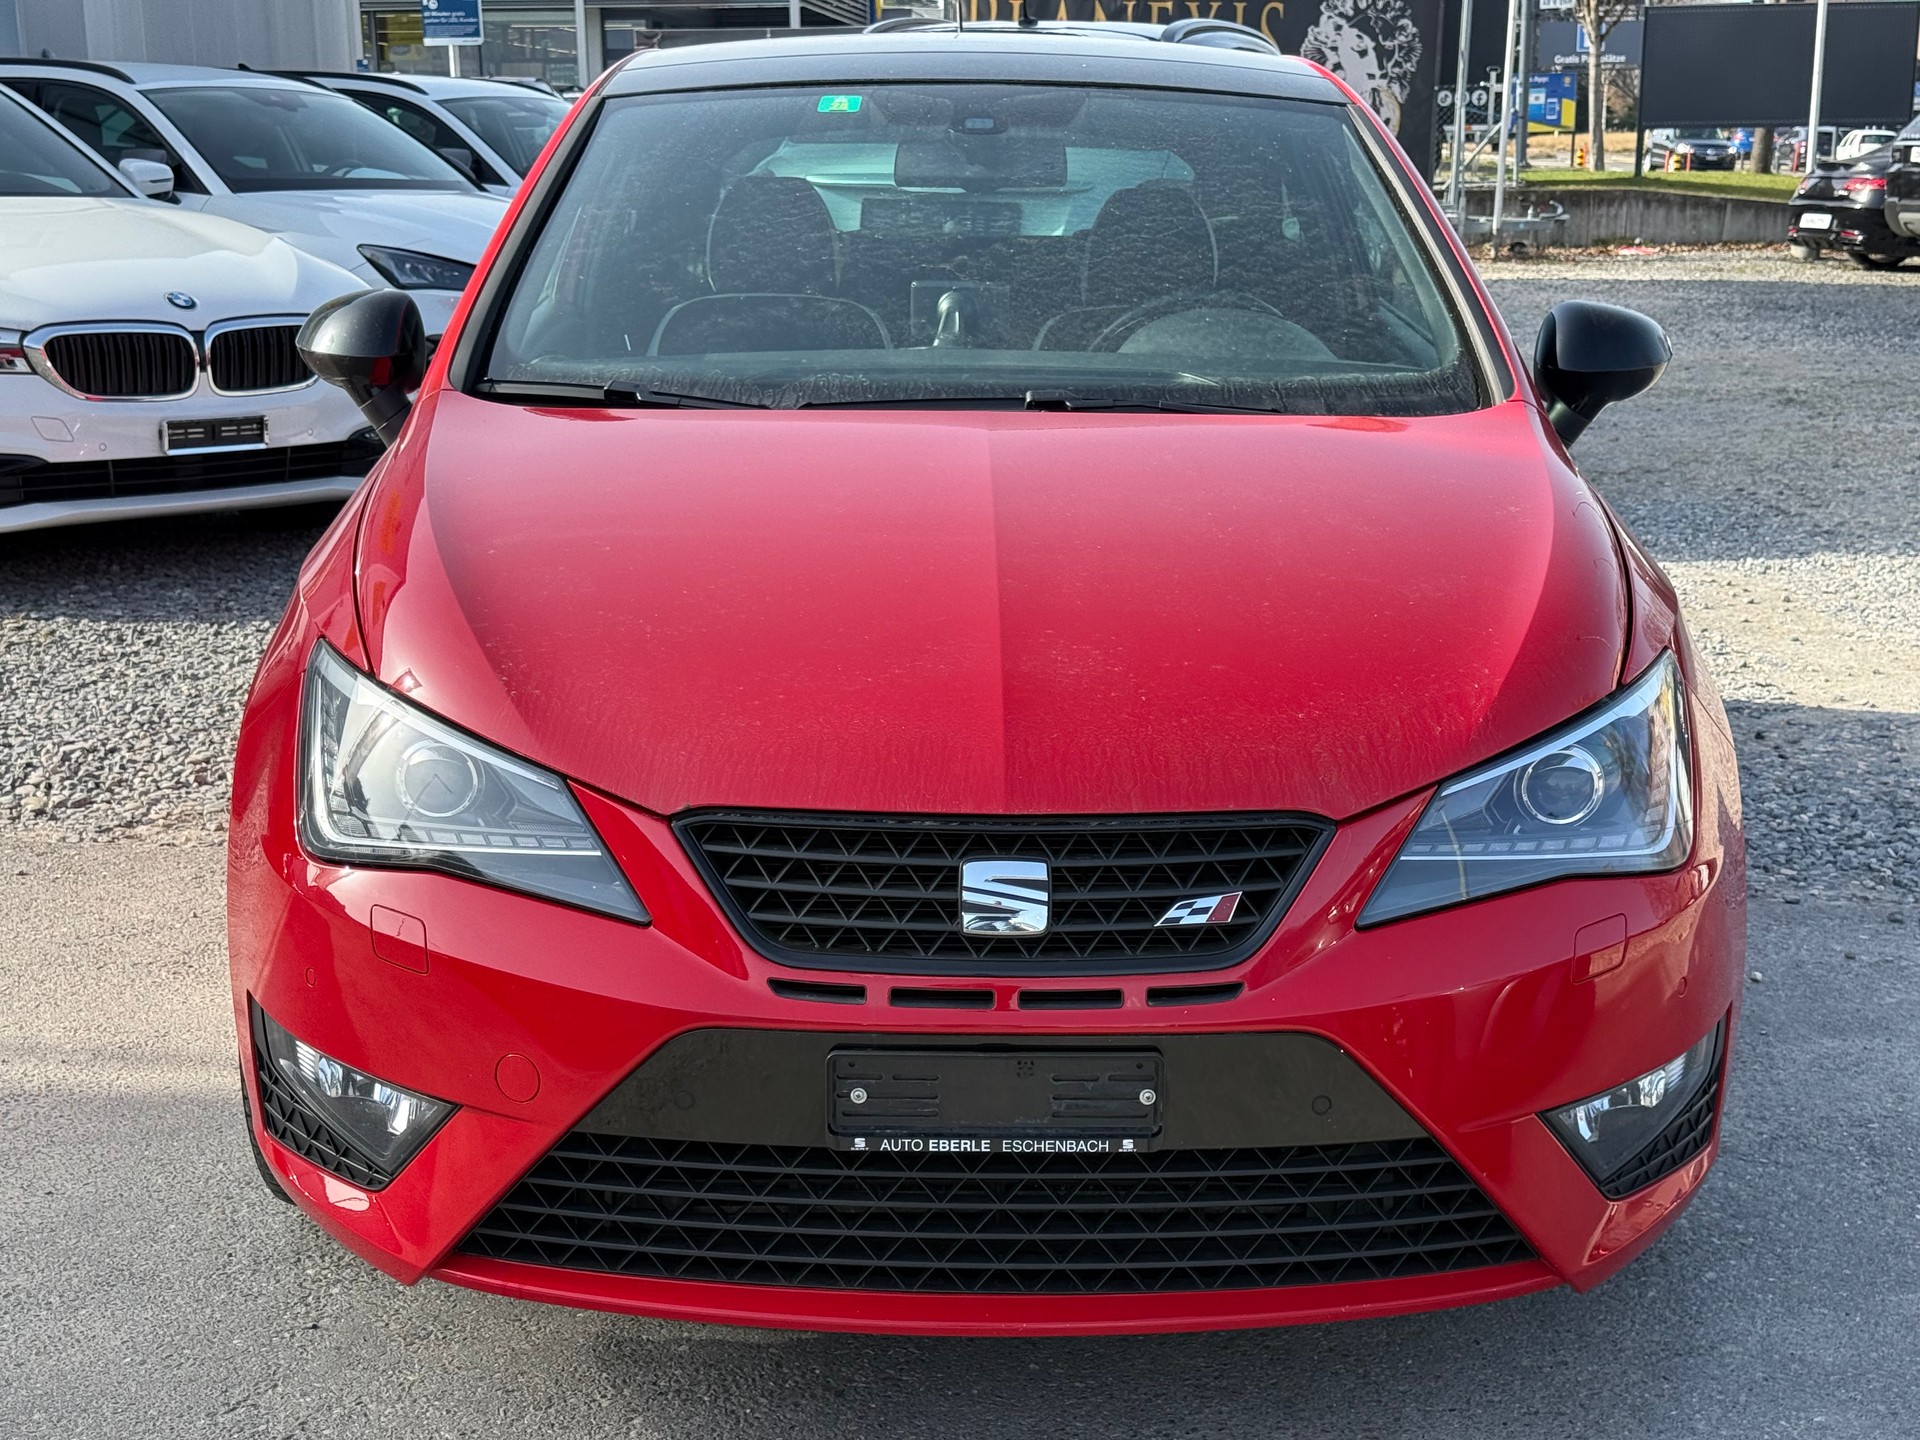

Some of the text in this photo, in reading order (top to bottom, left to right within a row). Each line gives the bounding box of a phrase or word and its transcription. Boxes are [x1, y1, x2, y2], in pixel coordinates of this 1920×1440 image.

[1554, 54, 1626, 64] Gratis Pplätze
[880, 1138, 1109, 1153] AUTO EBERLE ESCHENBACH
